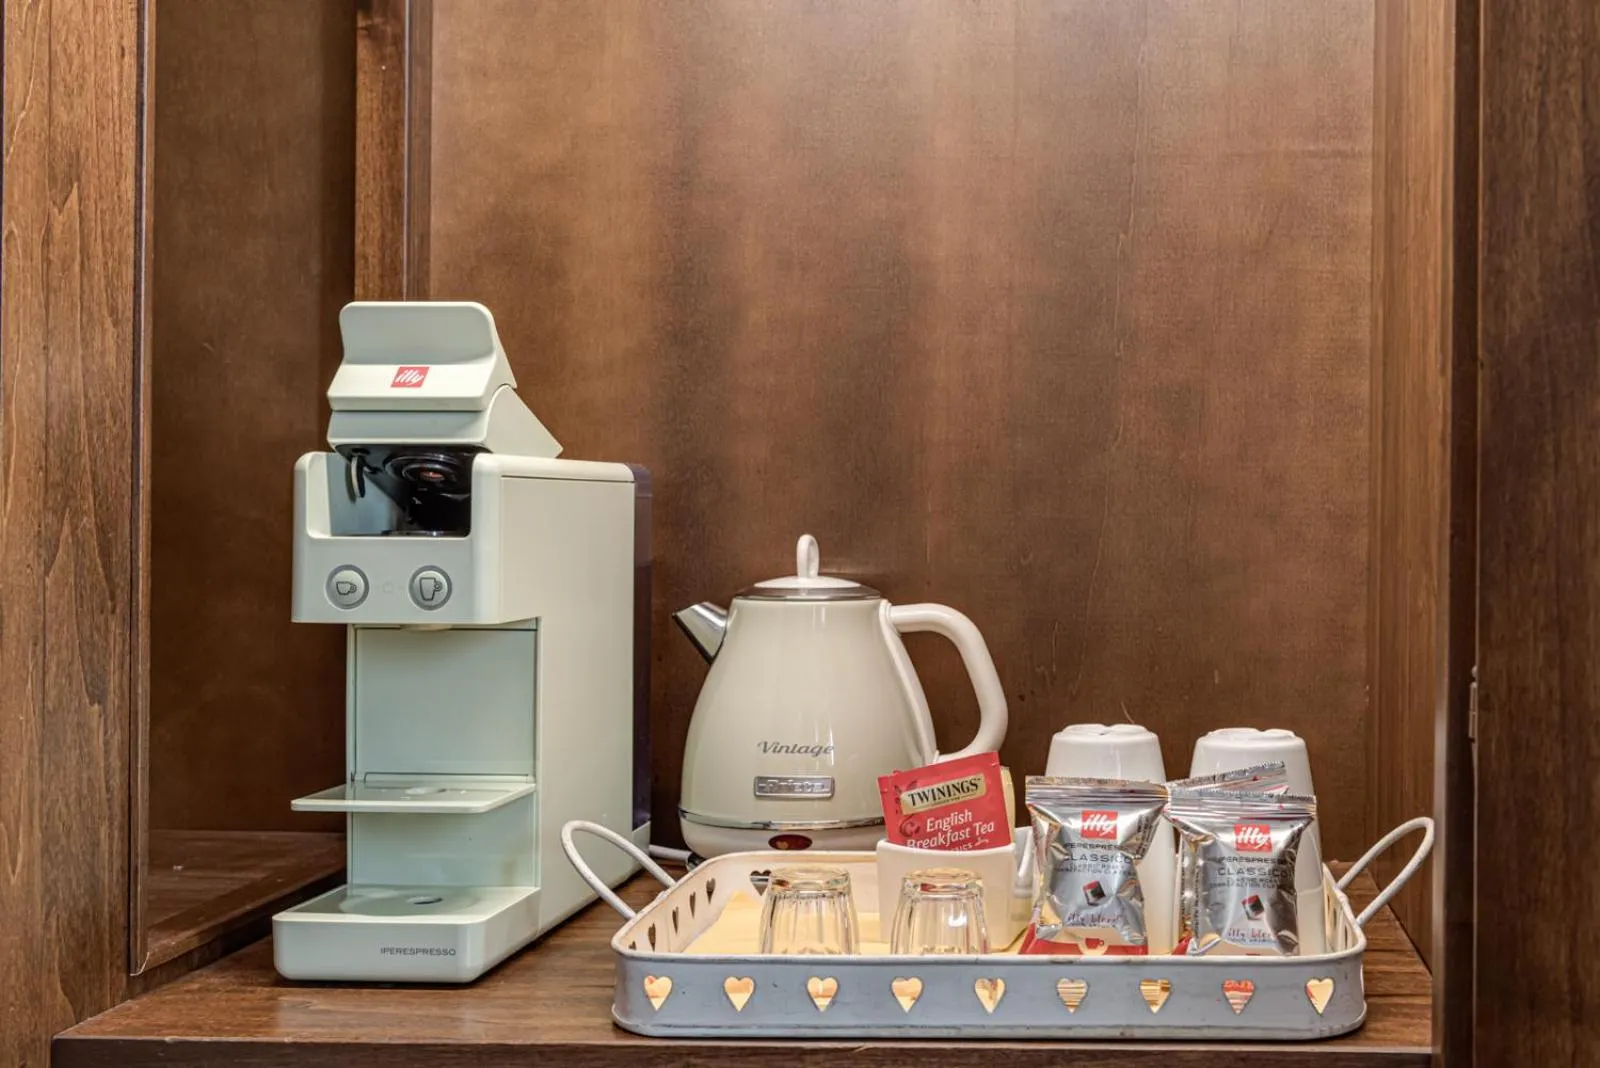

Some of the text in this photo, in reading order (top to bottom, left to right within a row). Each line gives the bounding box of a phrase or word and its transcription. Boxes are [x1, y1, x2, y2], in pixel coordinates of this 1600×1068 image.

[395, 368, 424, 386] illy
[757, 740, 835, 757] Vintage
[908, 778, 979, 807] TWININGS
[926, 808, 972, 832] English
[973, 821, 995, 836] Tea
[1082, 813, 1117, 836] illy
[1236, 826, 1271, 849] illy
[380, 947, 457, 956] IPERESPRESSO
